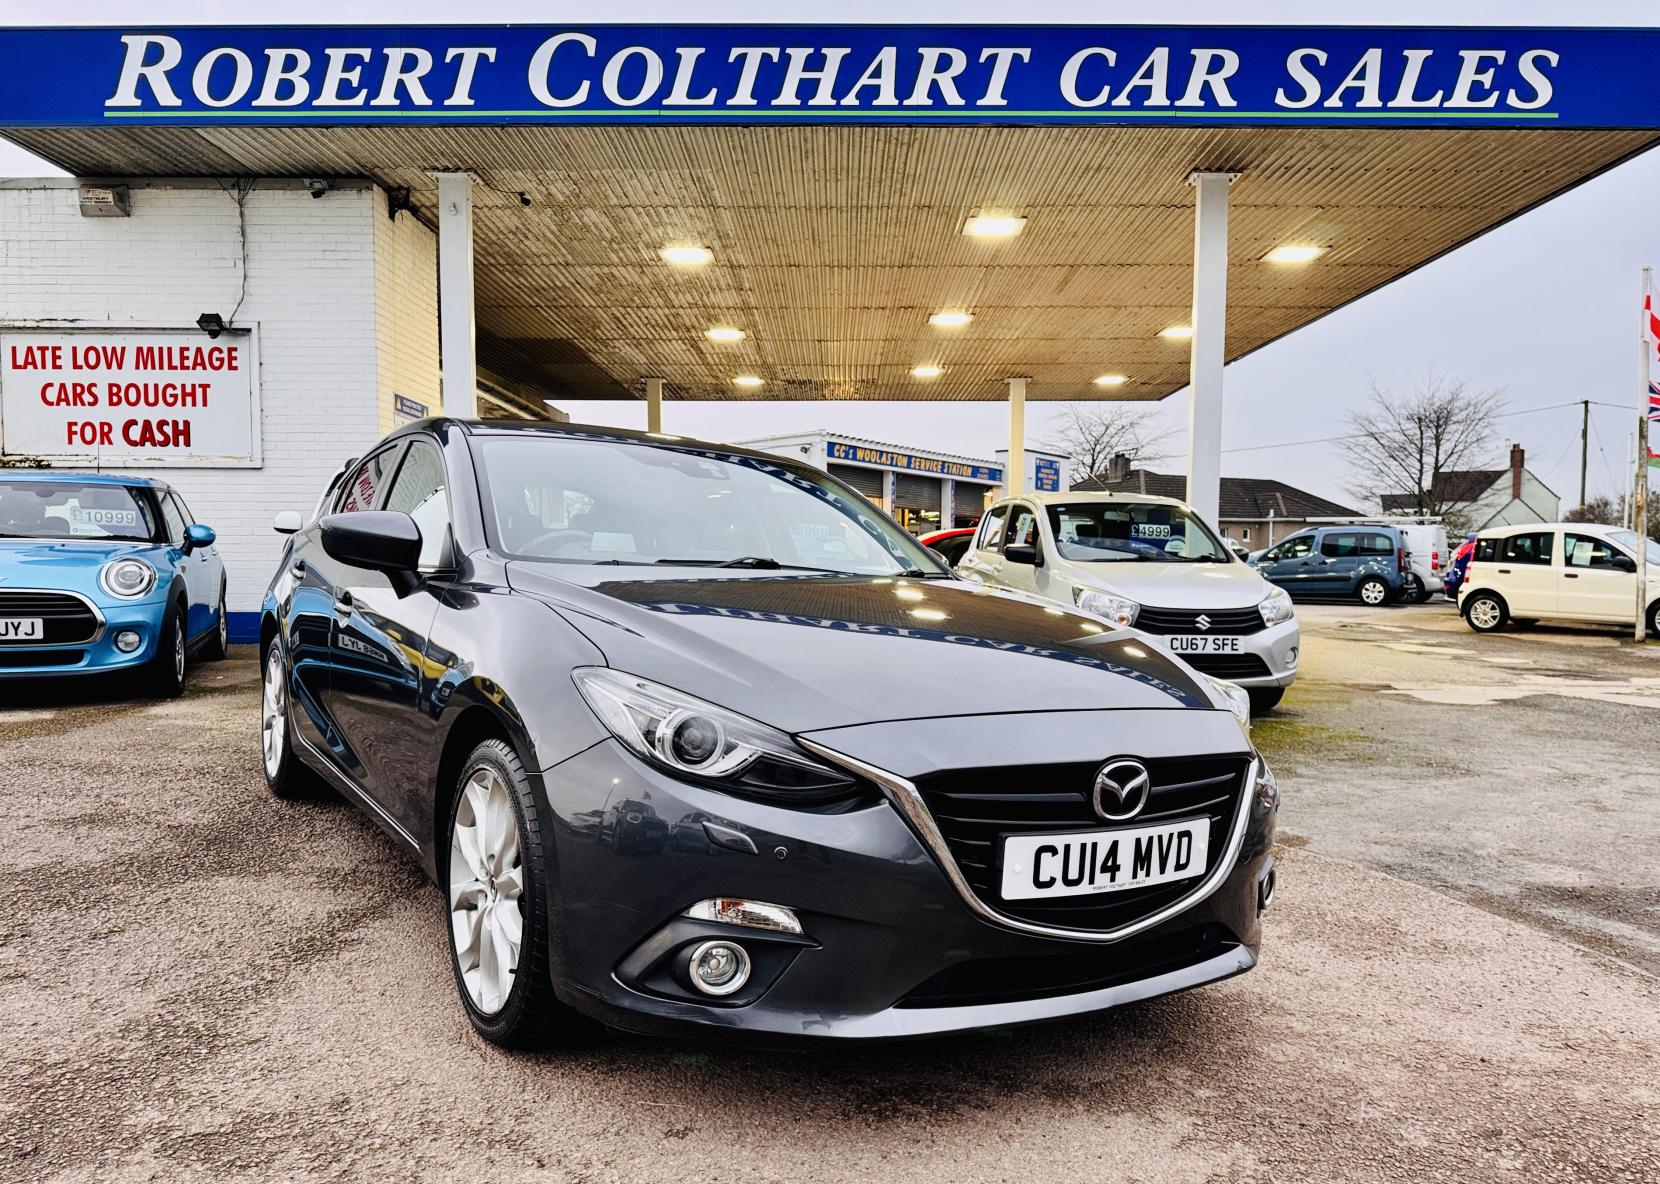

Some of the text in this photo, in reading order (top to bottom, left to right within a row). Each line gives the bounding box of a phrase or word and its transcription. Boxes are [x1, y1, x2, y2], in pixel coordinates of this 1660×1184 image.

[104, 33, 1561, 109] ROBERT COLTHART CAR SALES
[11, 345, 239, 371] LATE LOW MILEAGE
[40, 382, 211, 408] CARS BOUGHT
[67, 418, 191, 448] FOR CASH
[856, 447, 908, 468] WOOLASTON
[910, 456, 942, 473] SERVICE
[943, 460, 973, 477] STATION
[1131, 525, 1170, 538] £4999
[1170, 637, 1240, 652] CU67 SFE
[1032, 829, 1193, 890] CU14 MVD
